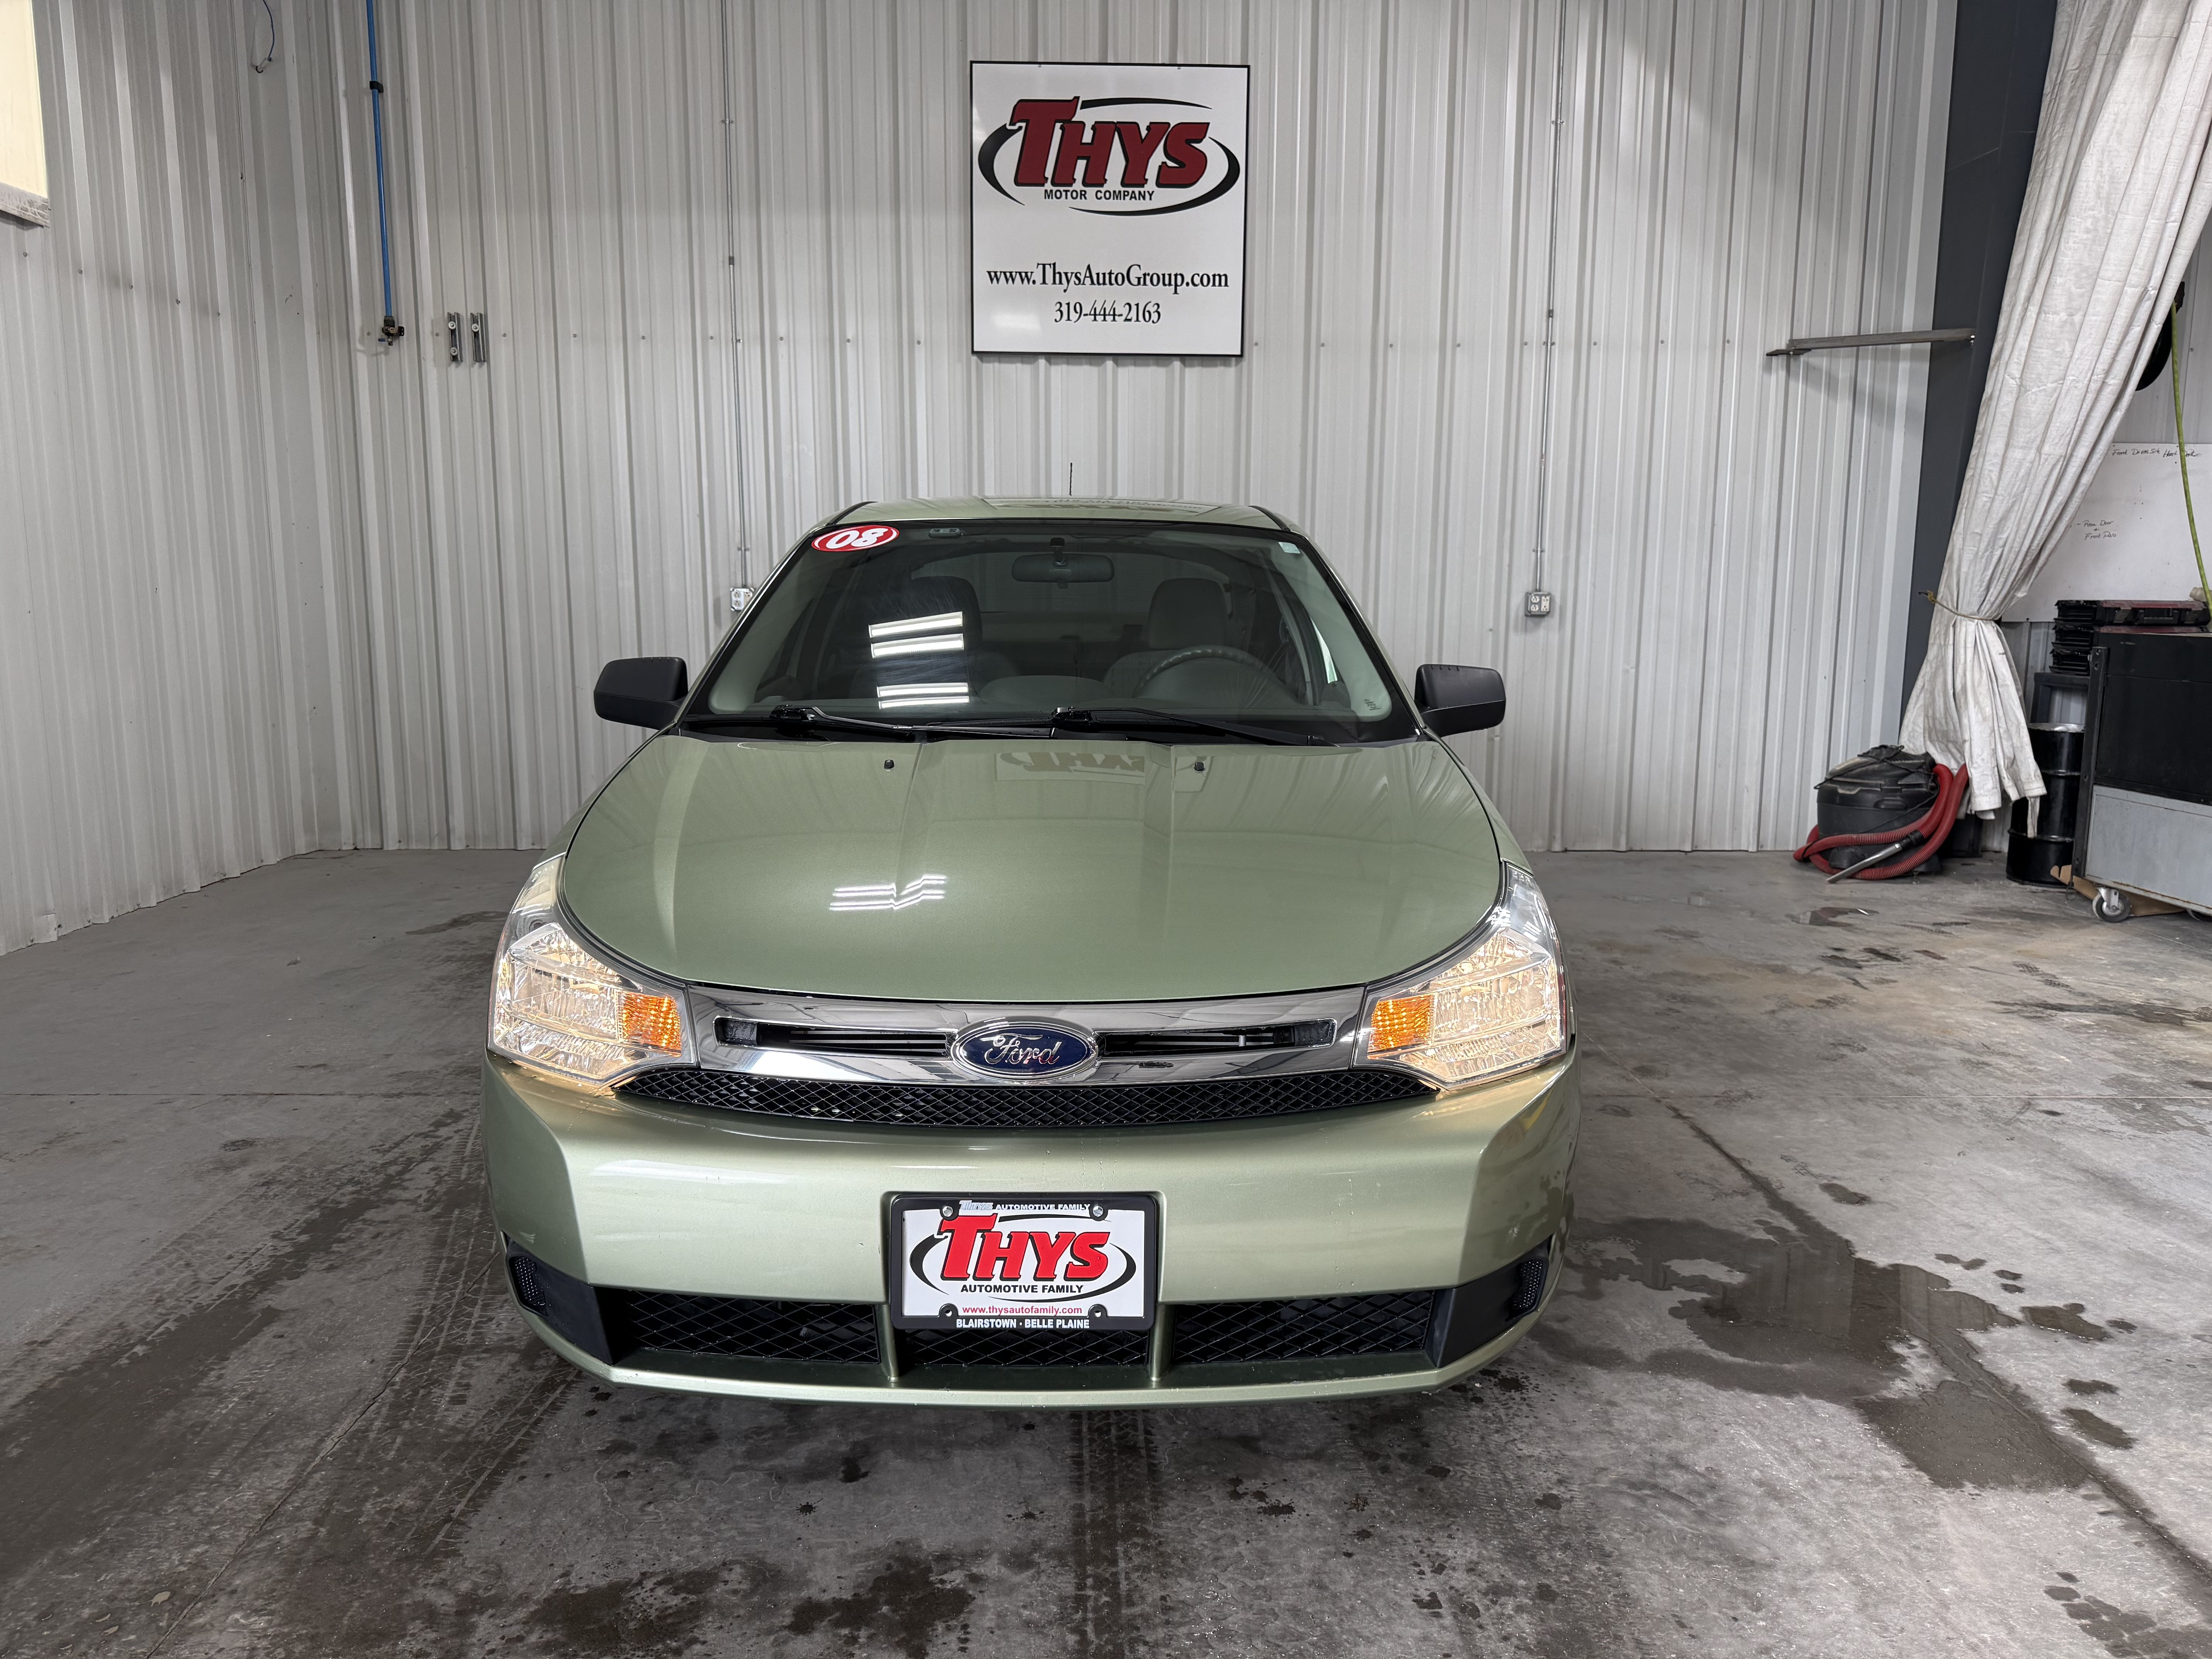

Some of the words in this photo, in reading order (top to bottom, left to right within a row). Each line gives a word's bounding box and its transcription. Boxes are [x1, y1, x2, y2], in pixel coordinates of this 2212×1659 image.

[1009, 96, 1210, 188] THYS
[1044, 189, 1087, 200] MOTOR
[1095, 190, 1154, 201] COMPANY
[986, 262, 1229, 294] www.ThysAutoGroup.com
[1054, 300, 1161, 324] 319-444-2163
[826, 528, 889, 549] 08
[984, 1033, 1062, 1065] Ford
[937, 1213, 1110, 1281] THYS
[960, 1285, 1038, 1293] AUTOMOTIVE
[1042, 1285, 1084, 1293] FAMILY
[962, 1305, 1082, 1316] www.thysautofamily.com
[956, 1319, 1017, 1328] BLAIRSTOWN
[1025, 1319, 1054, 1328] BELLE
[1056, 1319, 1090, 1329] PLAINE
